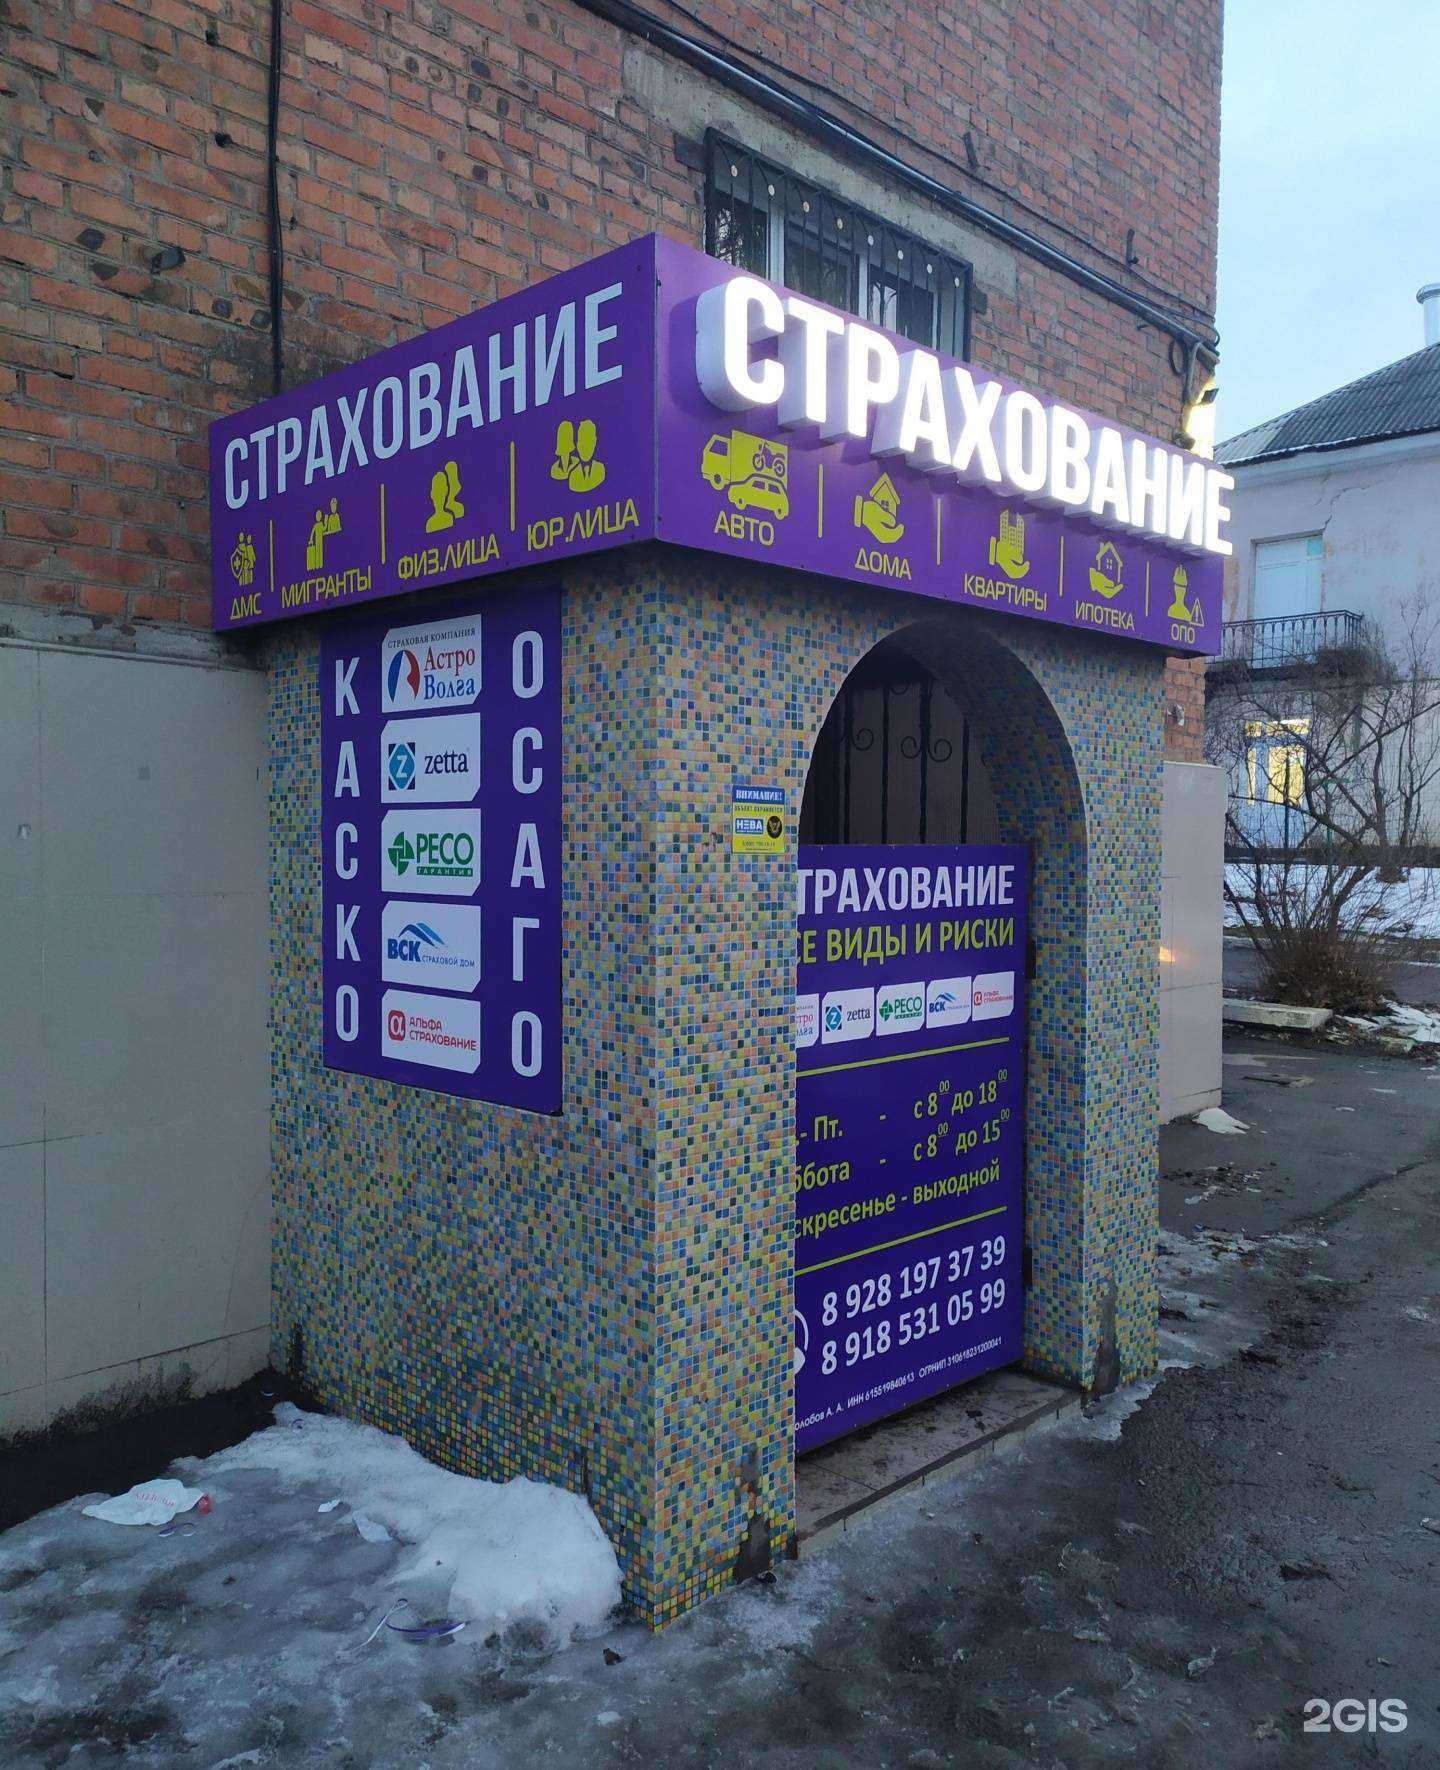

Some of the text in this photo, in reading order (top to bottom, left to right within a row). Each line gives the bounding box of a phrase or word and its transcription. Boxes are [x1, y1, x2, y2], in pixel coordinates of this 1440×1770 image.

[224, 282, 623, 510] СТРАХОВАНИЕ
[722, 276, 1235, 555] СТРАХОВАНИЕ
[527, 498, 640, 552] ЮР.ЛИЦА
[713, 512, 775, 546] АВТО
[397, 534, 500, 581] ФИЗ.ЛИЦА
[854, 547, 911, 581] ДОМА
[281, 565, 372, 609] МИГРАНТЫ
[963, 573, 1048, 612] КВАРТИРЫ
[230, 592, 261, 621] ДМС
[1075, 599, 1135, 632] ИПОТЕКА
[388, 627, 476, 648] СТРАХОВАЯ КОМПАНИЯ
[1170, 623, 1196, 644] ОПО
[424, 646, 475, 676] Астро
[424, 675, 475, 700] Волга
[424, 750, 469, 774] zetta
[416, 832, 474, 865] РЕСО
[797, 865, 1015, 915] ТРАХОВАНИЕ
[387, 938, 475, 968] ВСК СТРАХОВОЙ ДОМ
[826, 924, 907, 966] ВИДЫ
[915, 922, 931, 954] И
[940, 918, 1015, 951] РИСКИ
[846, 1008, 871, 1021] zetta
[929, 1001, 946, 1013] ВСК
[409, 1016, 442, 1032] АЛЬФА
[409, 1030, 477, 1052] СТРАХОВАНИЕ
[814, 1116, 843, 1142] Пт.
[951, 1090, 973, 1115] до
[955, 1130, 977, 1156] до
[822, 1235, 1006, 1327] 8 928 197 37 39
[821, 1278, 1006, 1375] 8 918 531 05 99
[847, 1393, 864, 1408] ИНН
[919, 1358, 947, 1378] ОГРНИП
